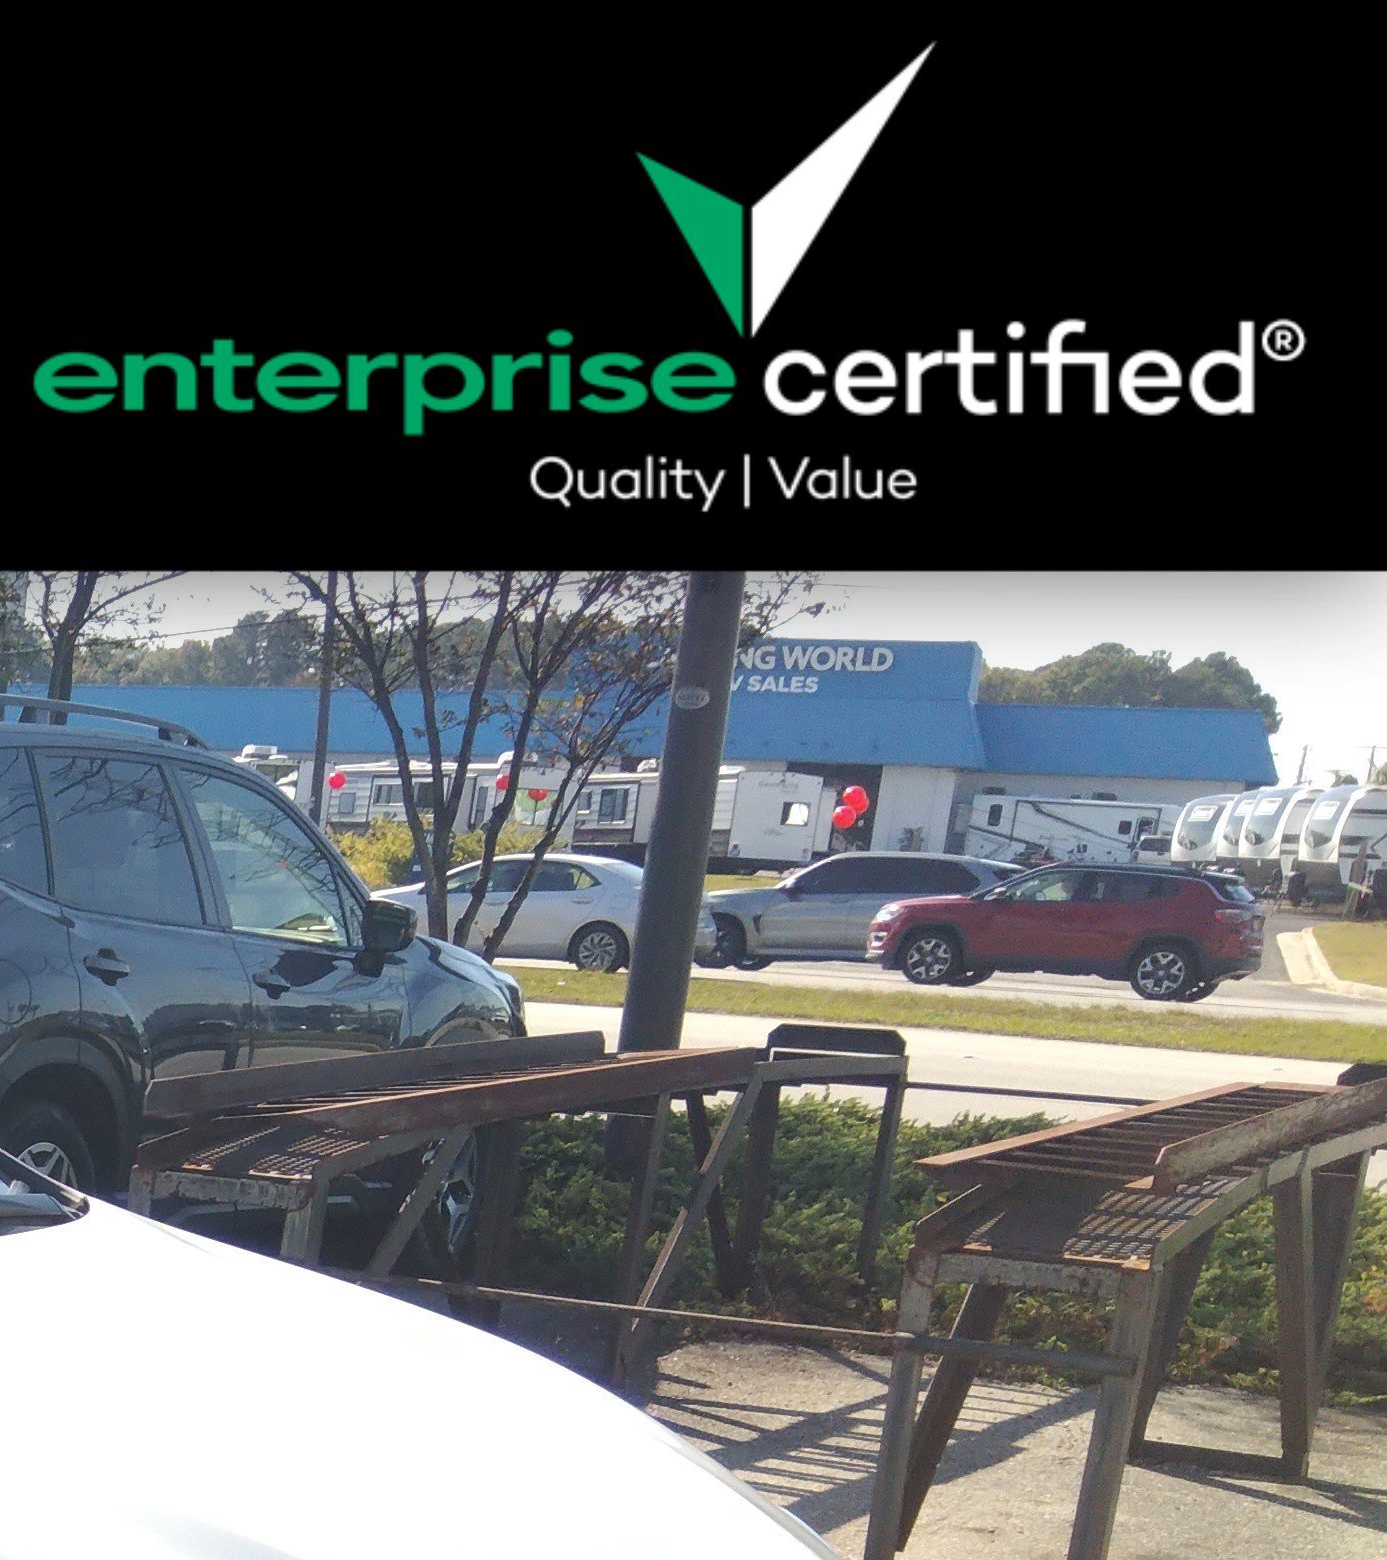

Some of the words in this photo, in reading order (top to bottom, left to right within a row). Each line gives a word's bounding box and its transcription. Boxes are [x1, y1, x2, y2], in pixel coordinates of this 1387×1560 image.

[733, 645, 776, 670] NG
[782, 645, 894, 672] WORLD
[747, 675, 819, 693] SALES
